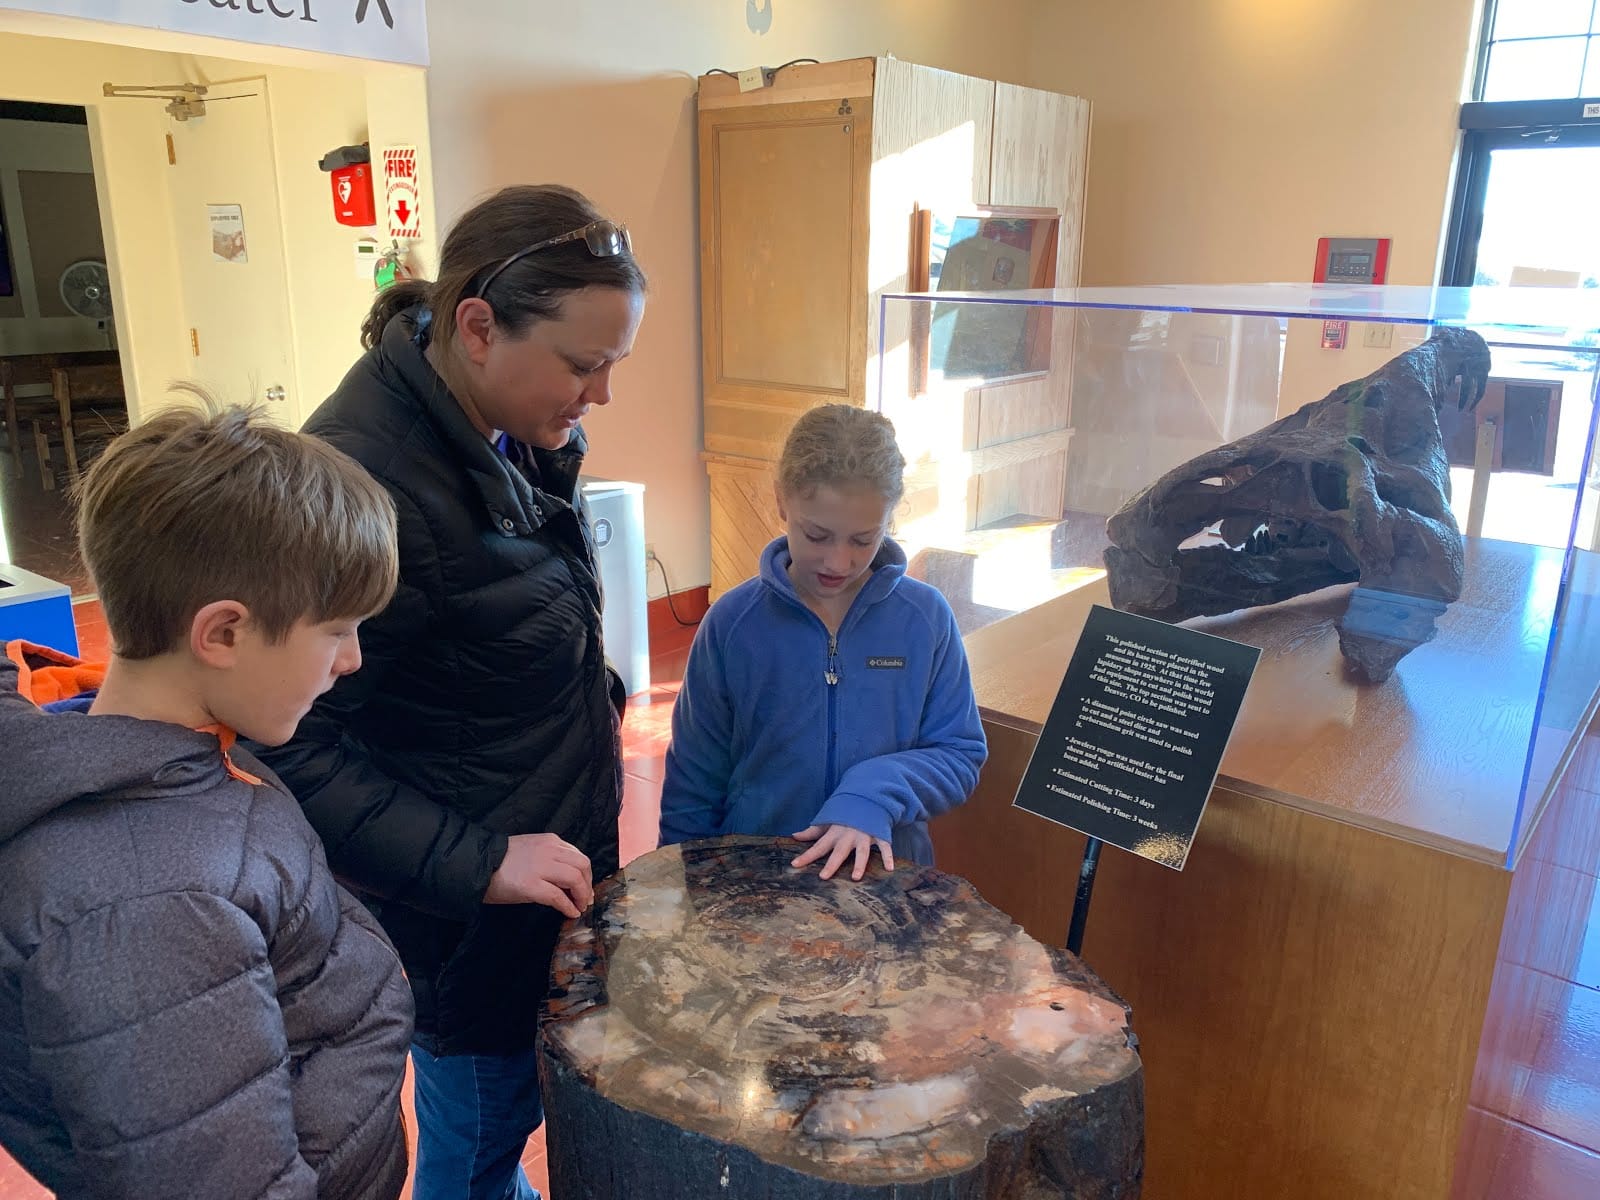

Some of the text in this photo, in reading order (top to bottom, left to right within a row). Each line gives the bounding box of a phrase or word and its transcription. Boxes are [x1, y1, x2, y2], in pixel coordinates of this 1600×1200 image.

[1587, 106, 1599, 115] THIS
[387, 159, 413, 178] FIRE
[1325, 320, 1342, 328] FIRE
[1105, 634, 1119, 643] This
[1118, 640, 1146, 651] polished
[1146, 647, 1168, 657] section
[1176, 656, 1205, 668] petrified
[1206, 664, 1224, 673] wood
[1150, 657, 1166, 666] were
[1166, 662, 1189, 672] placed
[1093, 665, 1106, 673] had
[1106, 670, 1139, 684] equipment
[1171, 690, 1192, 700] polish
[1193, 696, 1212, 706] wood
[1096, 658, 1123, 671] lapidary
[1123, 666, 1142, 676] shops
[1142, 672, 1174, 685] anywhere
[1182, 683, 1193, 691] the
[1194, 687, 1214, 697] world
[1168, 670, 1182, 679] that
[1183, 675, 1198, 684] time
[1198, 679, 1211, 687] few
[1103, 685, 1128, 698] Denver,
[1129, 693, 1141, 701] CO
[1158, 704, 1186, 716] polished.
[1126, 683, 1138, 692] The
[1138, 688, 1150, 696] top
[1150, 692, 1173, 703] section
[1187, 704, 1202, 712] sent
[1091, 700, 1119, 713] diamond
[1118, 710, 1136, 719] point
[1136, 715, 1155, 725] circle
[1169, 725, 1182, 733] was
[1183, 730, 1199, 739] used
[1118, 718, 1133, 726] steel
[1133, 722, 1147, 731] disc
[1063, 752, 1078, 762] been
[1148, 737, 1164, 746] used
[1171, 745, 1192, 755] polish
[1106, 760, 1134, 772] artificial
[1134, 768, 1153, 779] luster
[1154, 774, 1166, 784] has
[1128, 758, 1144, 767] used
[1144, 762, 1155, 770] for
[1155, 767, 1166, 775] the
[1167, 770, 1184, 781] final
[1057, 768, 1088, 784] Estimated
[1088, 780, 1113, 794] Cutting
[1114, 788, 1133, 801] Time:
[1138, 798, 1154, 808] days
[1050, 784, 1082, 800] Estimated
[1082, 796, 1111, 813] Polishing
[1113, 807, 1131, 819] Time:
[1138, 818, 1157, 829] weeks
